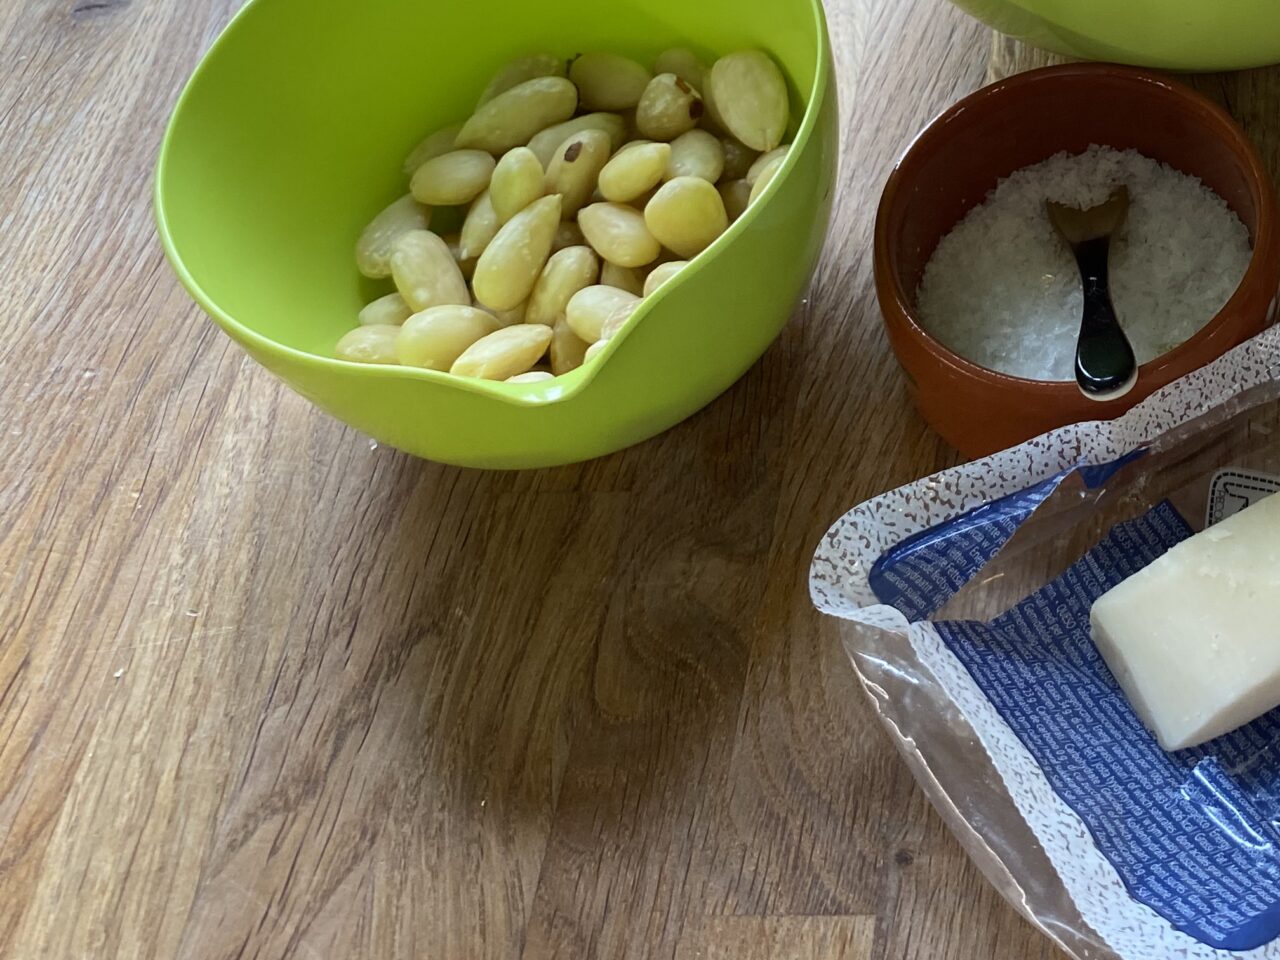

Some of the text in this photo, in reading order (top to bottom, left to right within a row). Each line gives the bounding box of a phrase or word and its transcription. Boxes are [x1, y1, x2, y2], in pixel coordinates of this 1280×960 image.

[1054, 602, 1077, 631] QUESO
[1069, 626, 1099, 662] PECORINO
[1042, 678, 1063, 702] Grasas
[1094, 743, 1114, 764] grassi
[1132, 786, 1154, 808] which
[1148, 805, 1176, 834] saturates
[1174, 832, 1195, 852] dont
[1188, 846, 1212, 867] acides
[1205, 863, 1223, 878] gras
[1063, 740, 1102, 786] Carbohydrate
[1122, 815, 1168, 862] Kohlenhydrate
[1082, 744, 1097, 760] fett
[1091, 759, 1112, 779] josta
[1145, 822, 1164, 839] tym
[1157, 834, 1180, 855] kwasy
[1112, 816, 1133, 842] which
[1126, 837, 1150, 862] sugars
[1149, 861, 1169, 879] dont
[1165, 874, 1188, 894] sucres
[1186, 892, 1212, 915] davon
[1193, 830, 1216, 853] Grassi
[1213, 851, 1228, 865] Fat
[1207, 828, 1233, 853] Energy
[1230, 850, 1252, 871] Valeur
[1170, 896, 1197, 919] Protein
